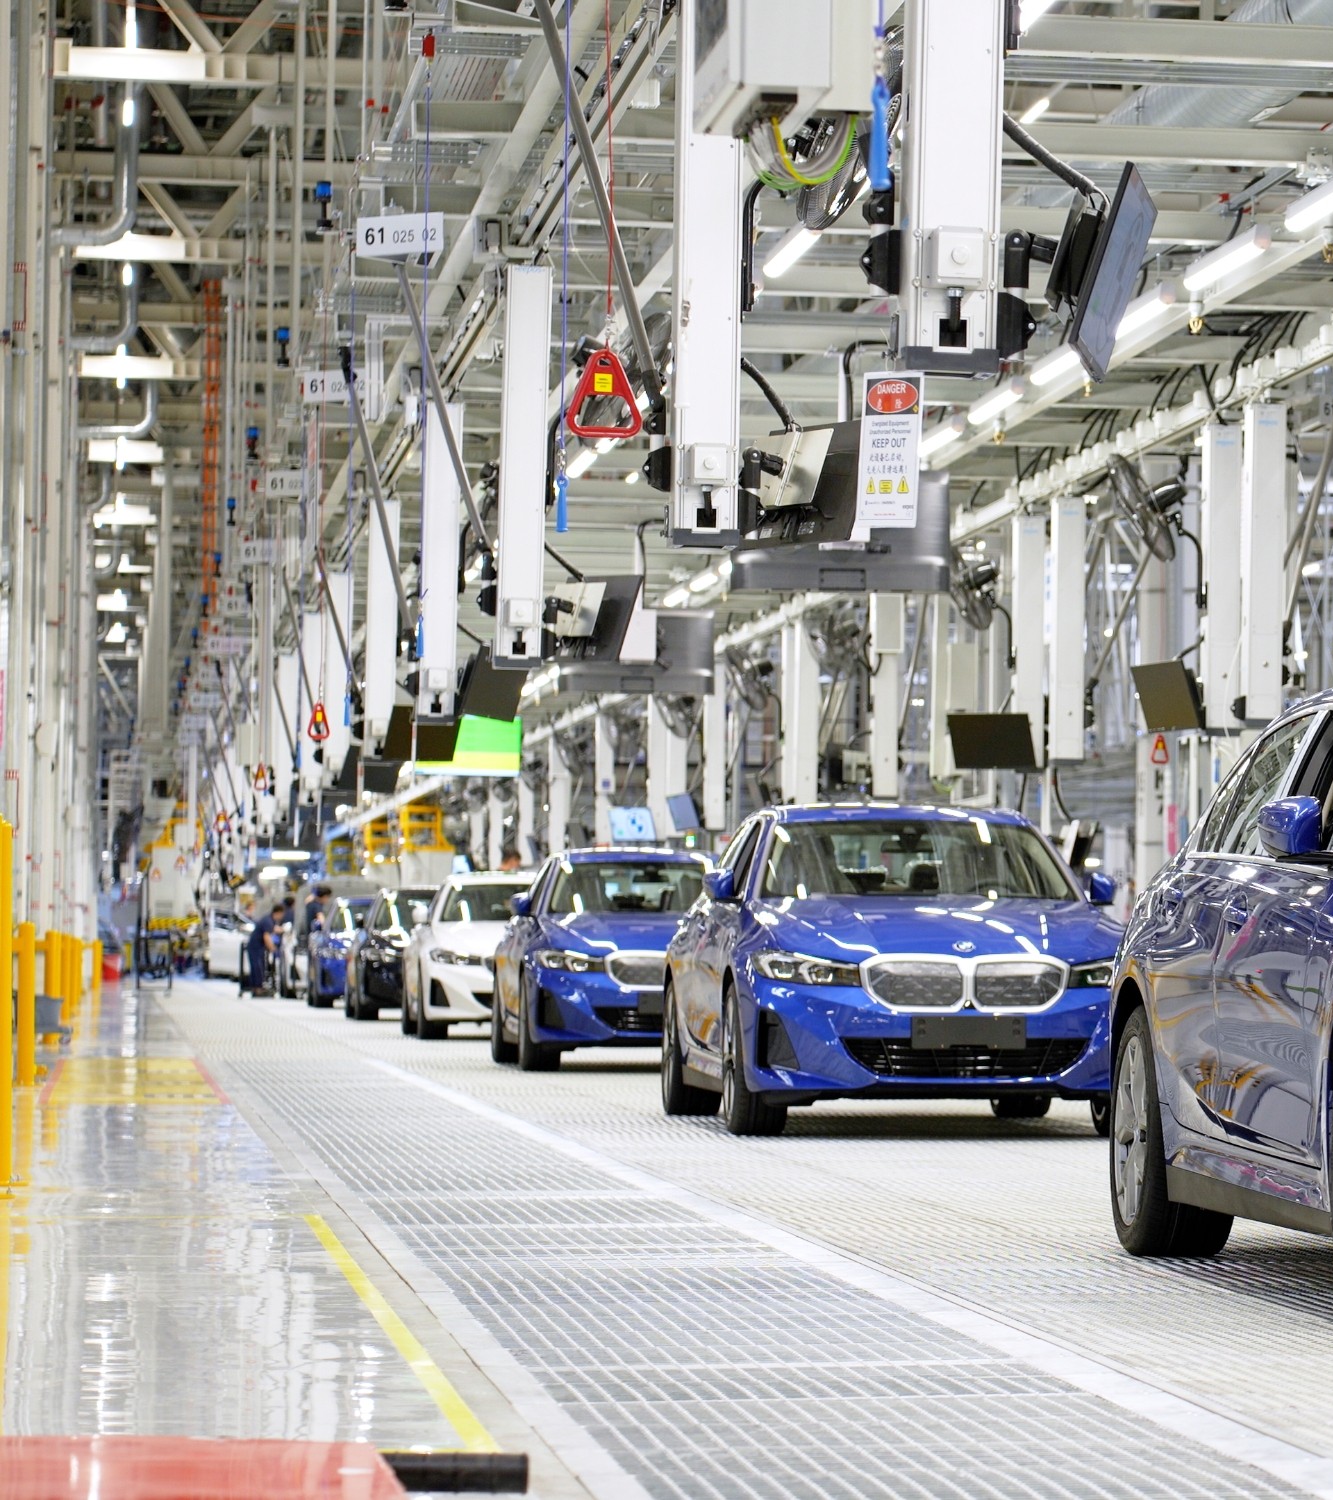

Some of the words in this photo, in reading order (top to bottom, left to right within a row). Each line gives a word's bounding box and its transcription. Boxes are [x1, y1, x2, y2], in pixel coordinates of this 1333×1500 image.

[365, 227, 385, 246] 61
[392, 229, 415, 244] 025
[421, 227, 437, 242] 02
[310, 378, 325, 394] 61
[877, 383, 906, 395] DANGER
[871, 438, 890, 448] KEEP
[891, 437, 906, 448] OUT
[270, 477, 285, 490] 61
